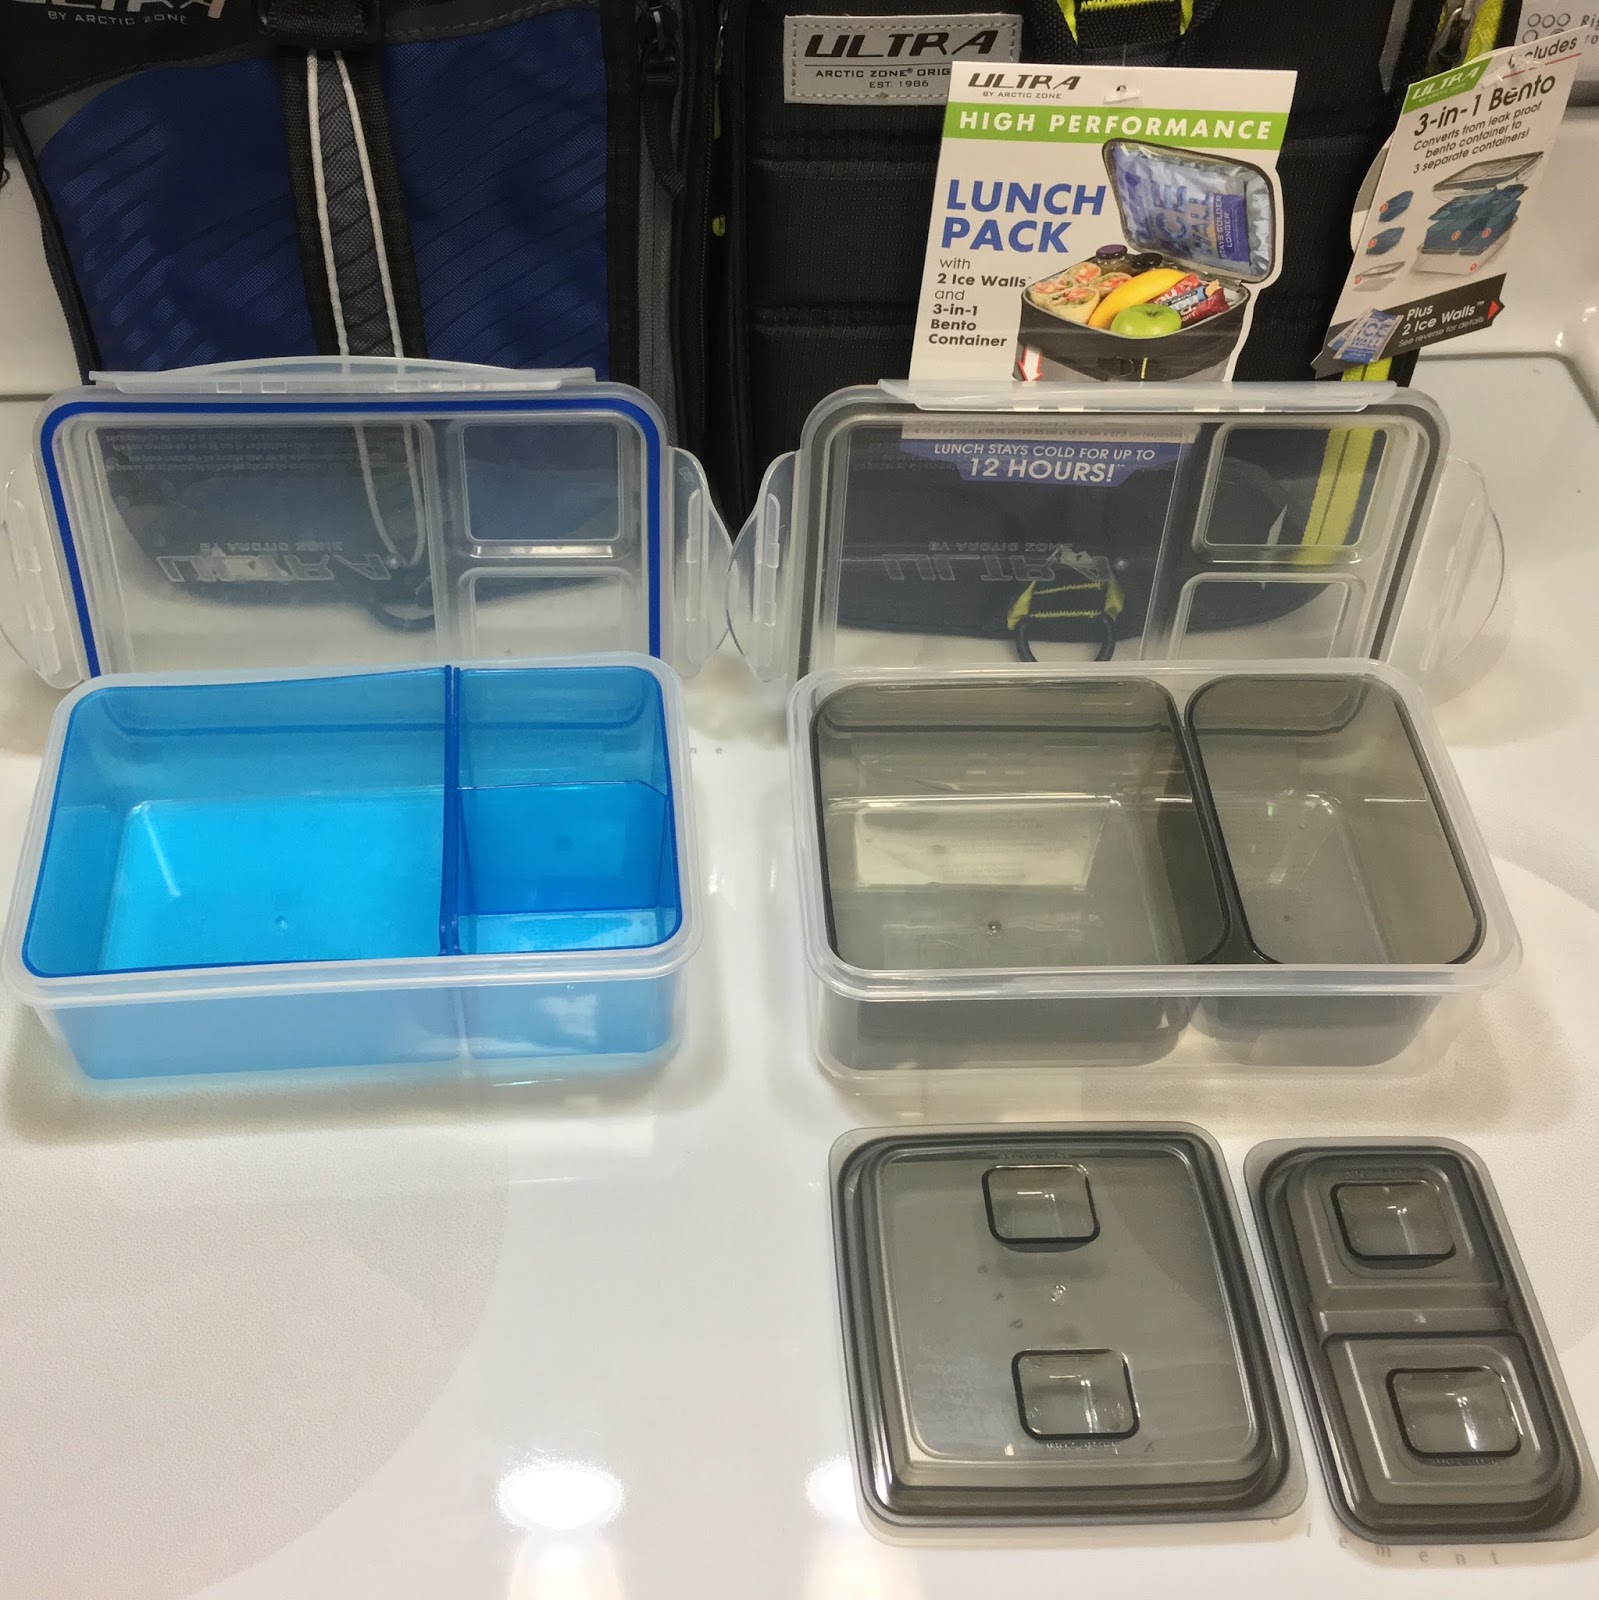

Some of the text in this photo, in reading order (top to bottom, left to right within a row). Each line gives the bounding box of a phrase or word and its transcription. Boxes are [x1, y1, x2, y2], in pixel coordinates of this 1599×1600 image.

[47, 10, 188, 26] BY ARCTIC ZONE
[804, 30, 999, 58] ULTRA
[816, 70, 864, 78] ARCTIC
[968, 73, 1081, 91] ULTRA
[1412, 66, 1480, 99] ULTRA
[869, 80, 929, 89] EST. 1986
[982, 91, 994, 99] BY
[997, 91, 1033, 99] ARCTIC
[959, 111, 1272, 140] HIGH PERFORMANCE
[1413, 101, 1543, 151] Converts from leak proof
[1425, 119, 1522, 159] bento container to
[1413, 163, 1420, 174] 3
[1422, 150, 1469, 172] separate
[946, 179, 1106, 216] LUNCH
[941, 217, 1073, 253] PACK
[940, 257, 971, 270] with
[937, 273, 947, 284] 2
[952, 274, 975, 286] Ice
[935, 290, 965, 301] and
[933, 303, 978, 316] 3-in-1
[1406, 304, 1434, 321] Plus
[930, 319, 977, 331] Bento
[1402, 323, 1412, 336] 2
[1414, 316, 1437, 333] Ice
[928, 334, 1007, 347] Container
[934, 443, 1155, 461] LUNCH STAYS COLD FOR UP TO
[969, 457, 1000, 477] 12
